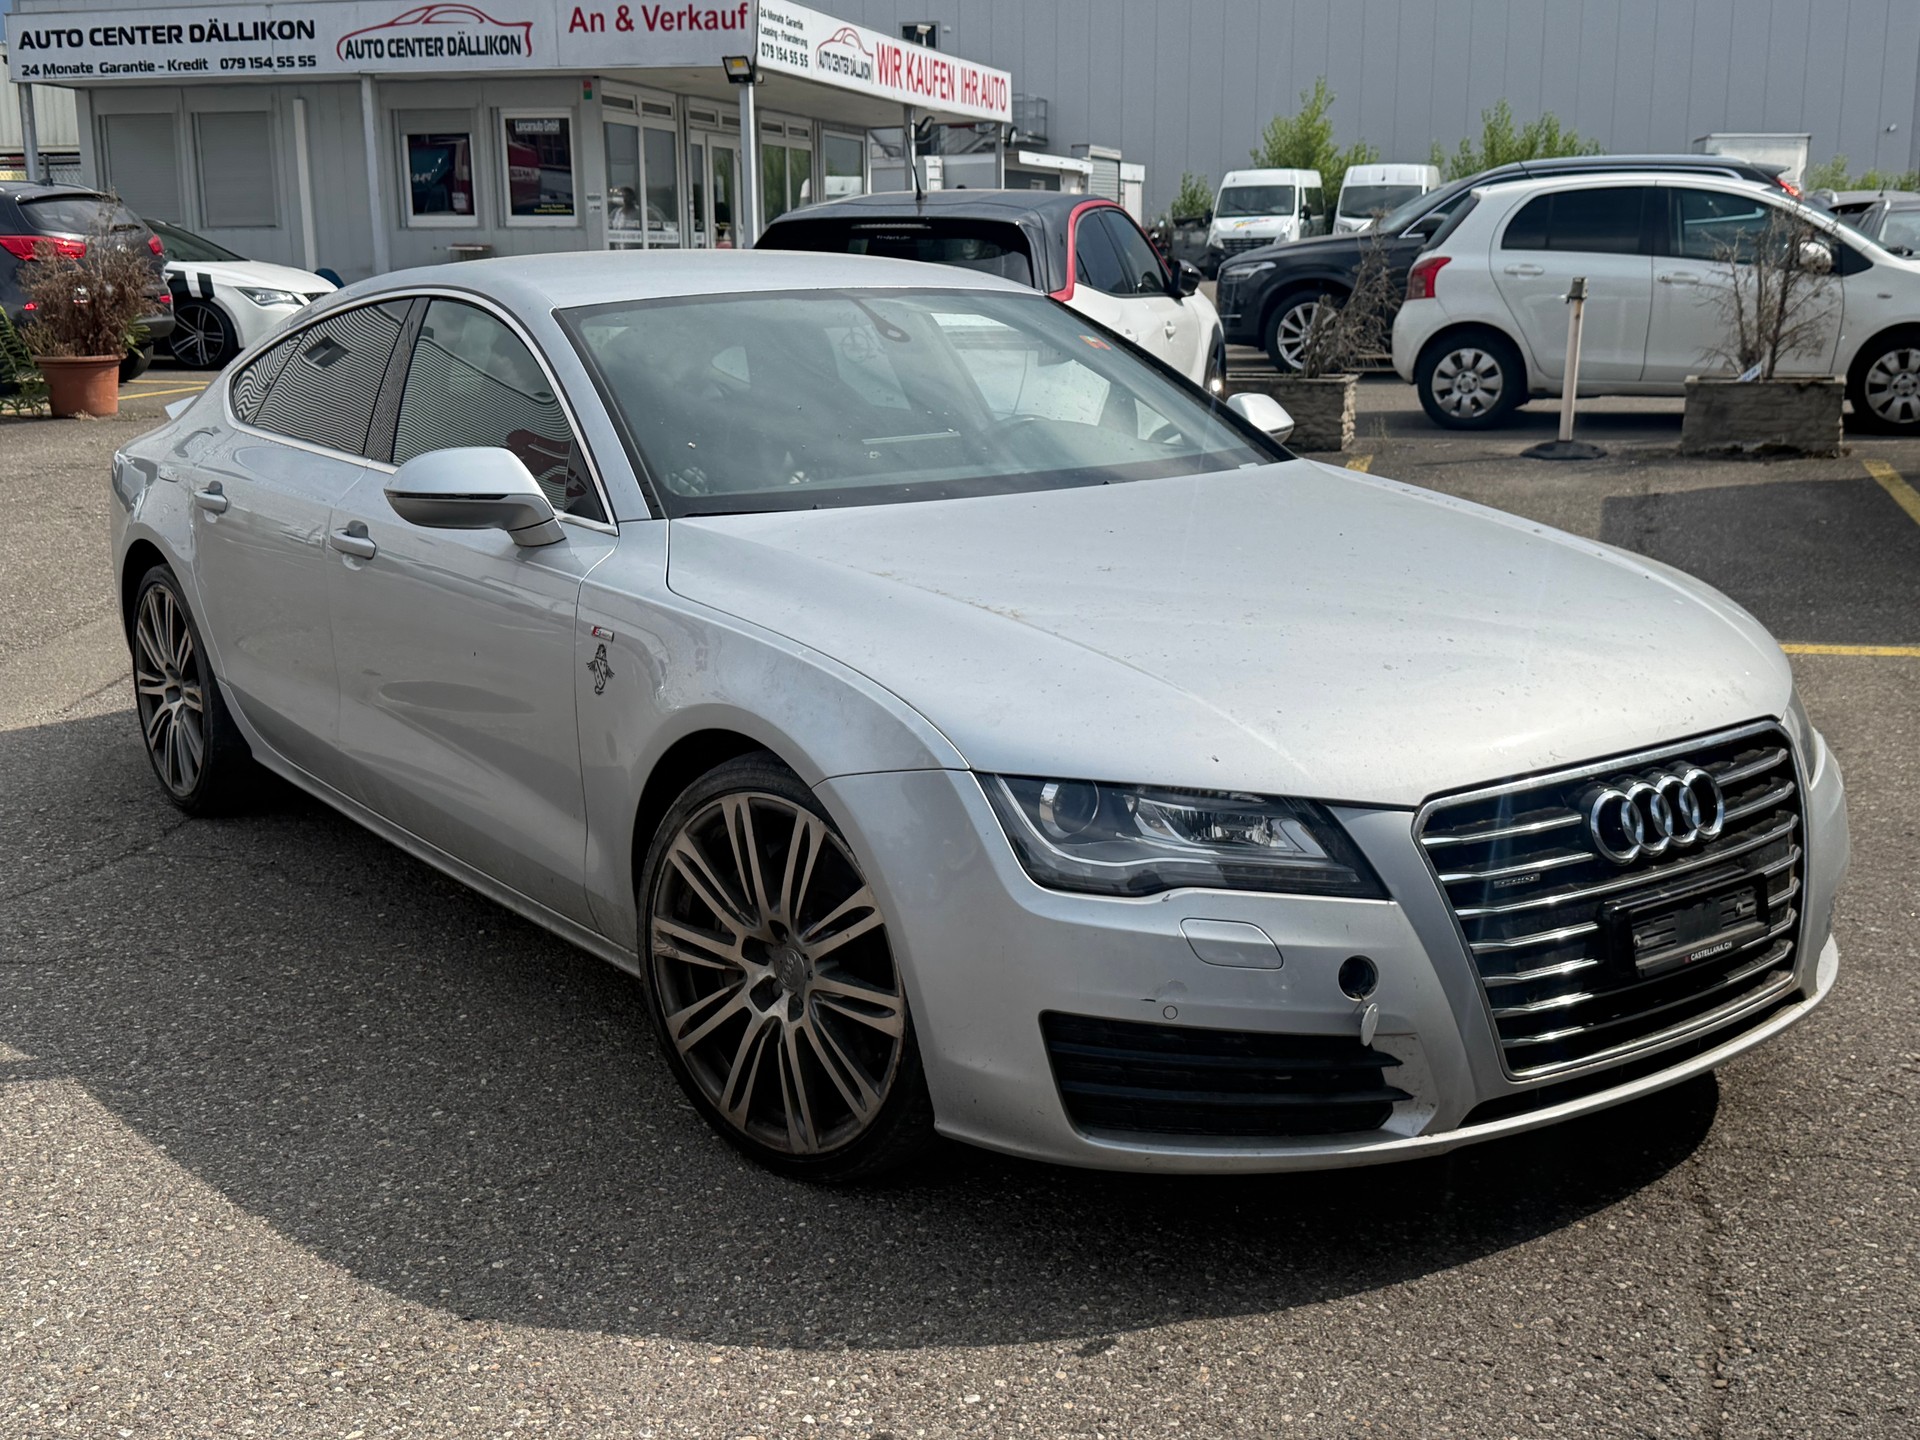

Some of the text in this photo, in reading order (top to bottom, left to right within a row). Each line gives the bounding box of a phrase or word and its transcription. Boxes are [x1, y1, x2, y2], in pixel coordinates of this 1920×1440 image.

[568, 2, 748, 33] An & Verkauf
[768, 9, 784, 24] Monate
[786, 15, 803, 30] Garantie
[18, 18, 315, 50] AUTO CENTER DÄLLIKON
[760, 23, 778, 40] Leasing
[345, 31, 521, 60] AUTO CENTER DÄLLIKON
[761, 42, 808, 68] 079 154 55 55
[21, 64, 40, 77] 24
[43, 62, 94, 75] Monate
[99, 60, 155, 74] Garantie
[167, 57, 209, 71] Kredit
[219, 57, 246, 70] 079
[248, 56, 274, 69] 154
[276, 55, 295, 68] 55
[298, 54, 317, 67] 55
[876, 41, 1007, 113] WIR KAUFEN IHR AUTO
